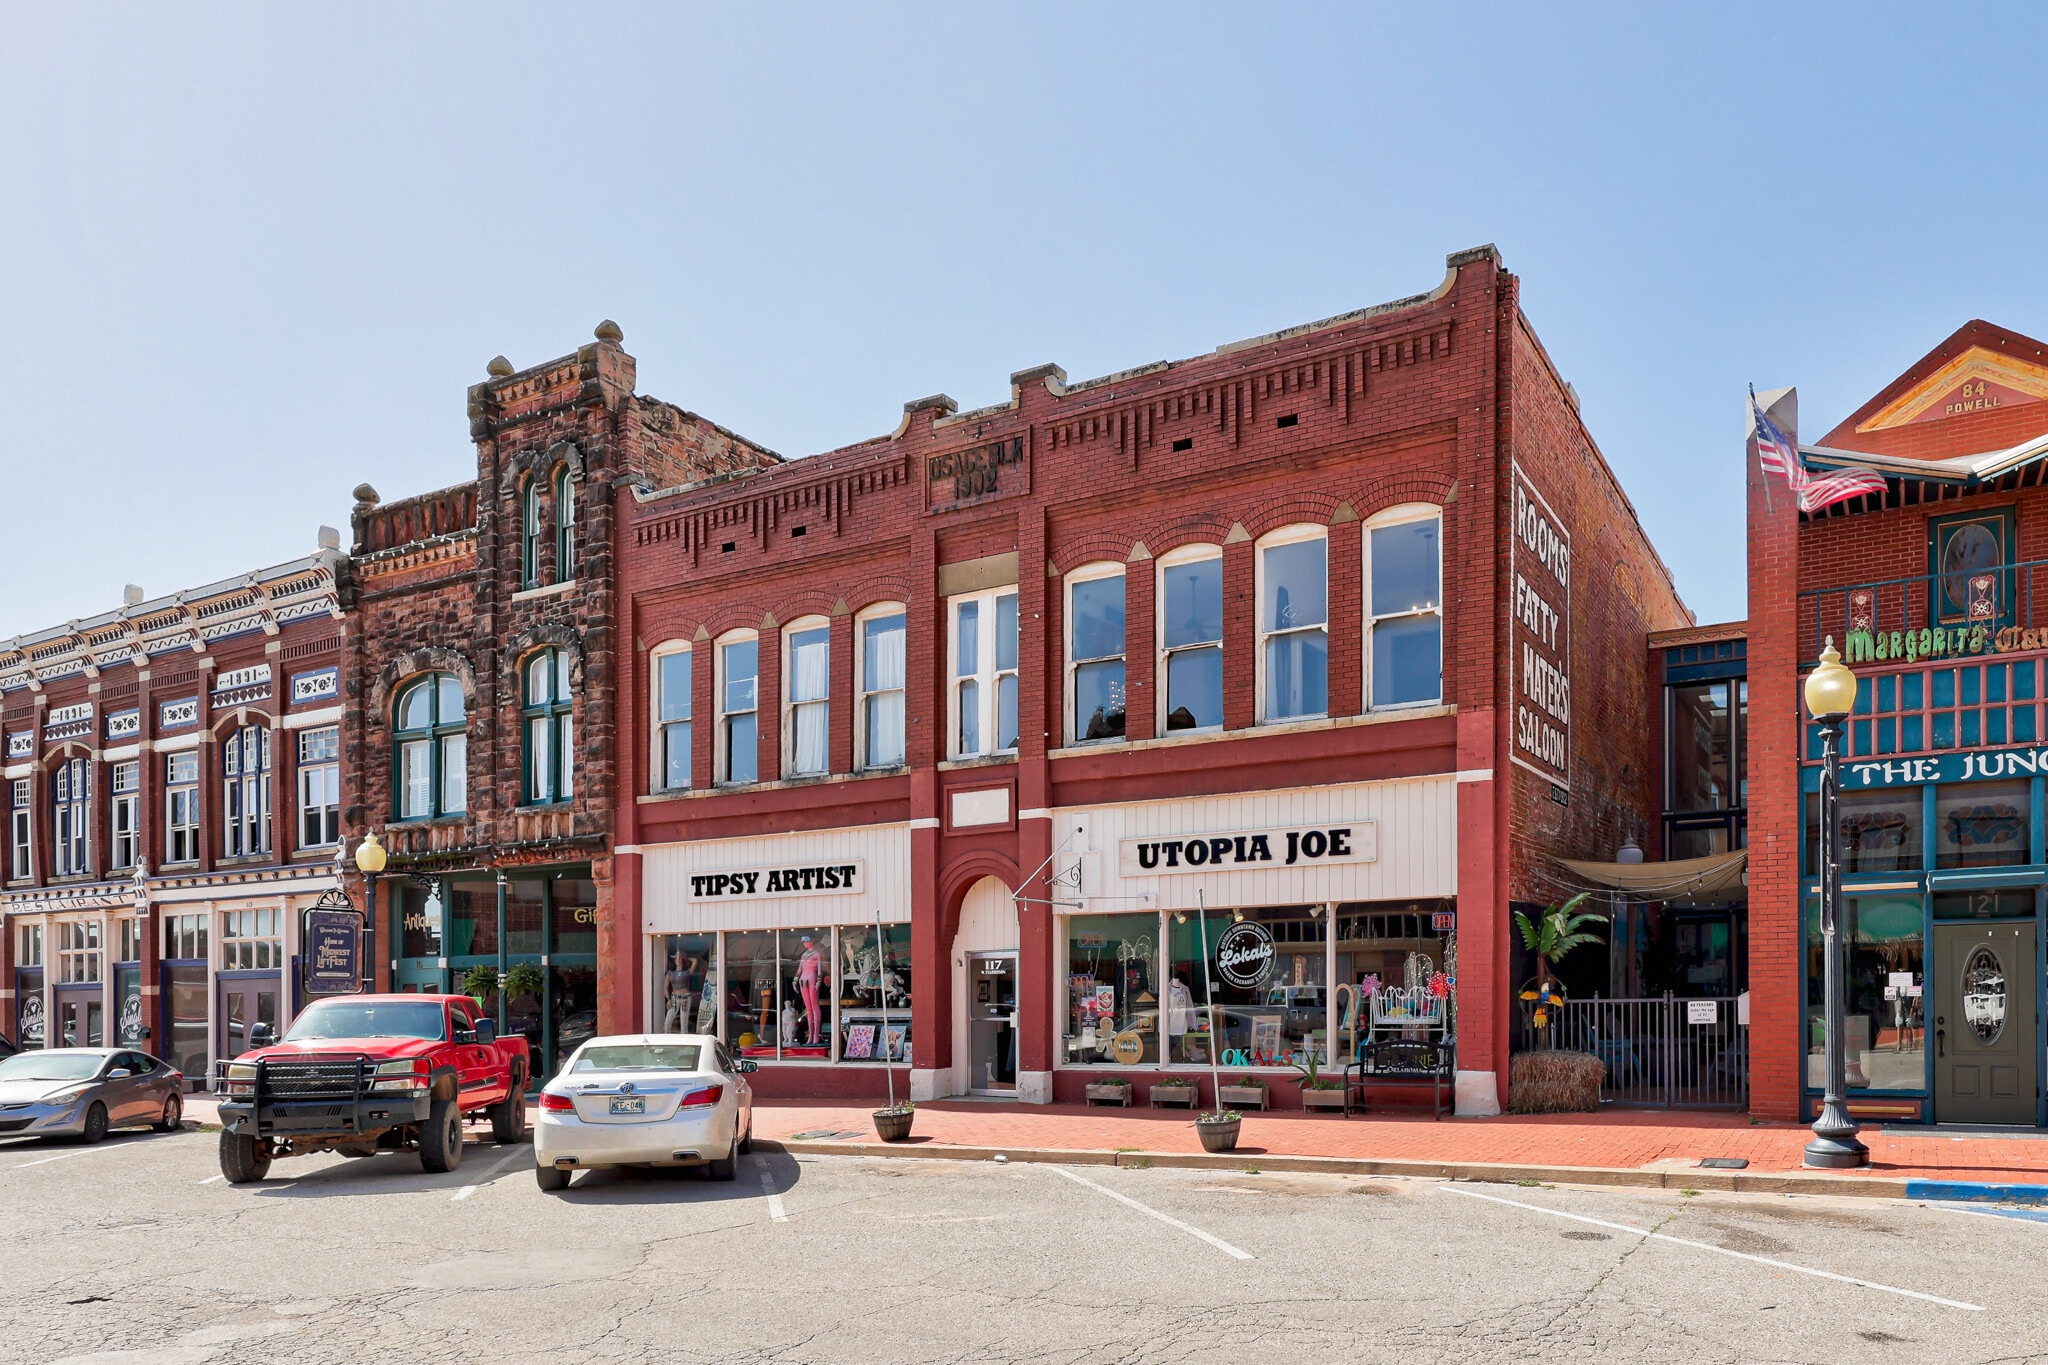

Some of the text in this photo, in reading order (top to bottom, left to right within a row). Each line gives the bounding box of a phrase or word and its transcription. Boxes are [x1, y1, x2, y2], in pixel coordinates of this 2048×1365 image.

[1962, 381, 1986, 398] 84
[1946, 396, 2001, 416] POWELL
[928, 445, 987, 481] OSAGE
[954, 467, 998, 500] 1902
[1517, 484, 1568, 589] ROOMS
[1516, 572, 1559, 651] FATTY
[1523, 640, 1568, 725] MATER'S
[1518, 703, 1565, 771] SALOON
[1852, 757, 1941, 785] THE
[1137, 828, 1351, 869] UTOPIA JOE
[691, 865, 856, 897] TIPSY ARTIST
[12, 894, 128, 913] RESTAURANT
[1968, 894, 1999, 914] 121
[1433, 914, 1453, 929] OPEN
[1080, 933, 1106, 946] OPEN
[985, 959, 1003, 970] 117
